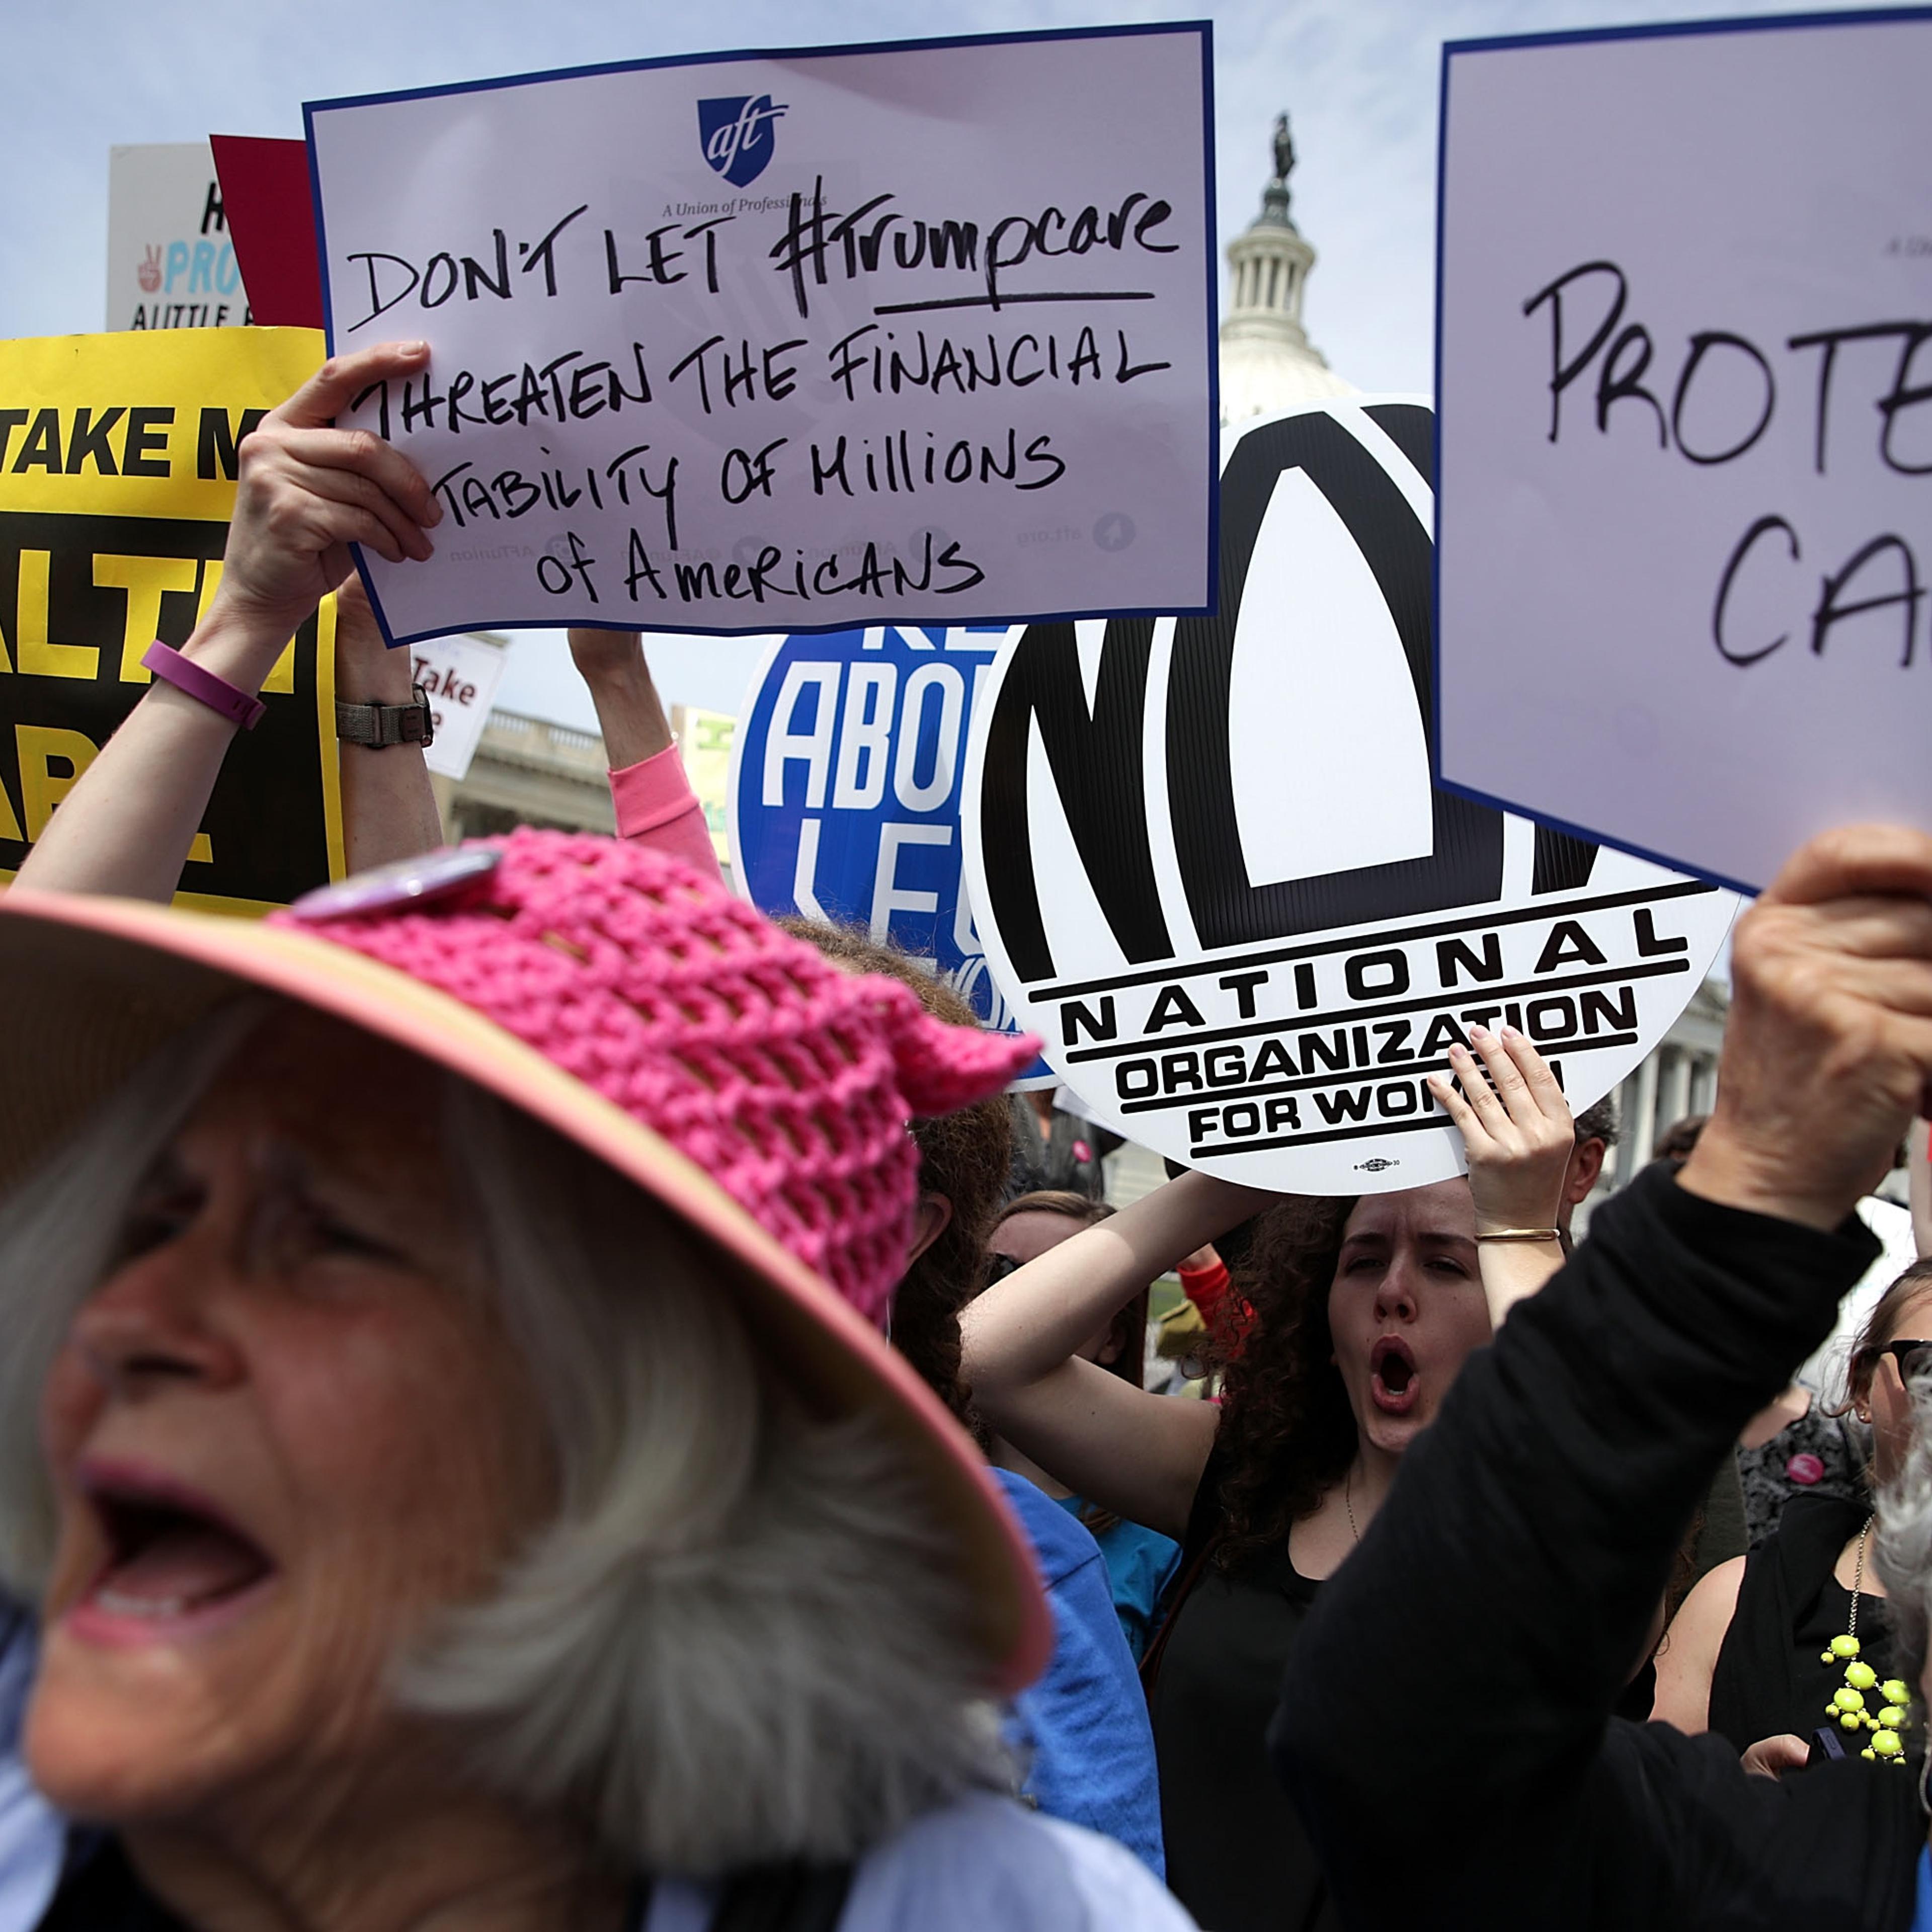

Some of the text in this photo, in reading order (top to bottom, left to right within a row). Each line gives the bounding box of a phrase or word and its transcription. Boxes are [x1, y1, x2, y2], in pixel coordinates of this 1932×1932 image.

[707, 94, 788, 177] aft
[346, 175, 1180, 333] DON'T LET #Trumpcare
[662, 204, 672, 217] A
[676, 202, 718, 216] Union
[721, 199, 737, 214] of
[351, 343, 653, 441] THREATEN
[669, 335, 808, 415] THE
[432, 445, 678, 551] TABILITY
[1713, 515, 1932, 668] CA
[414, 657, 475, 705] Take
[763, 662, 991, 815] ABO
[1061, 909, 1688, 1046] NATIONAL
[1115, 986, 1638, 1100] ORGANIZATION
[1188, 1097, 1302, 1143] FOR
